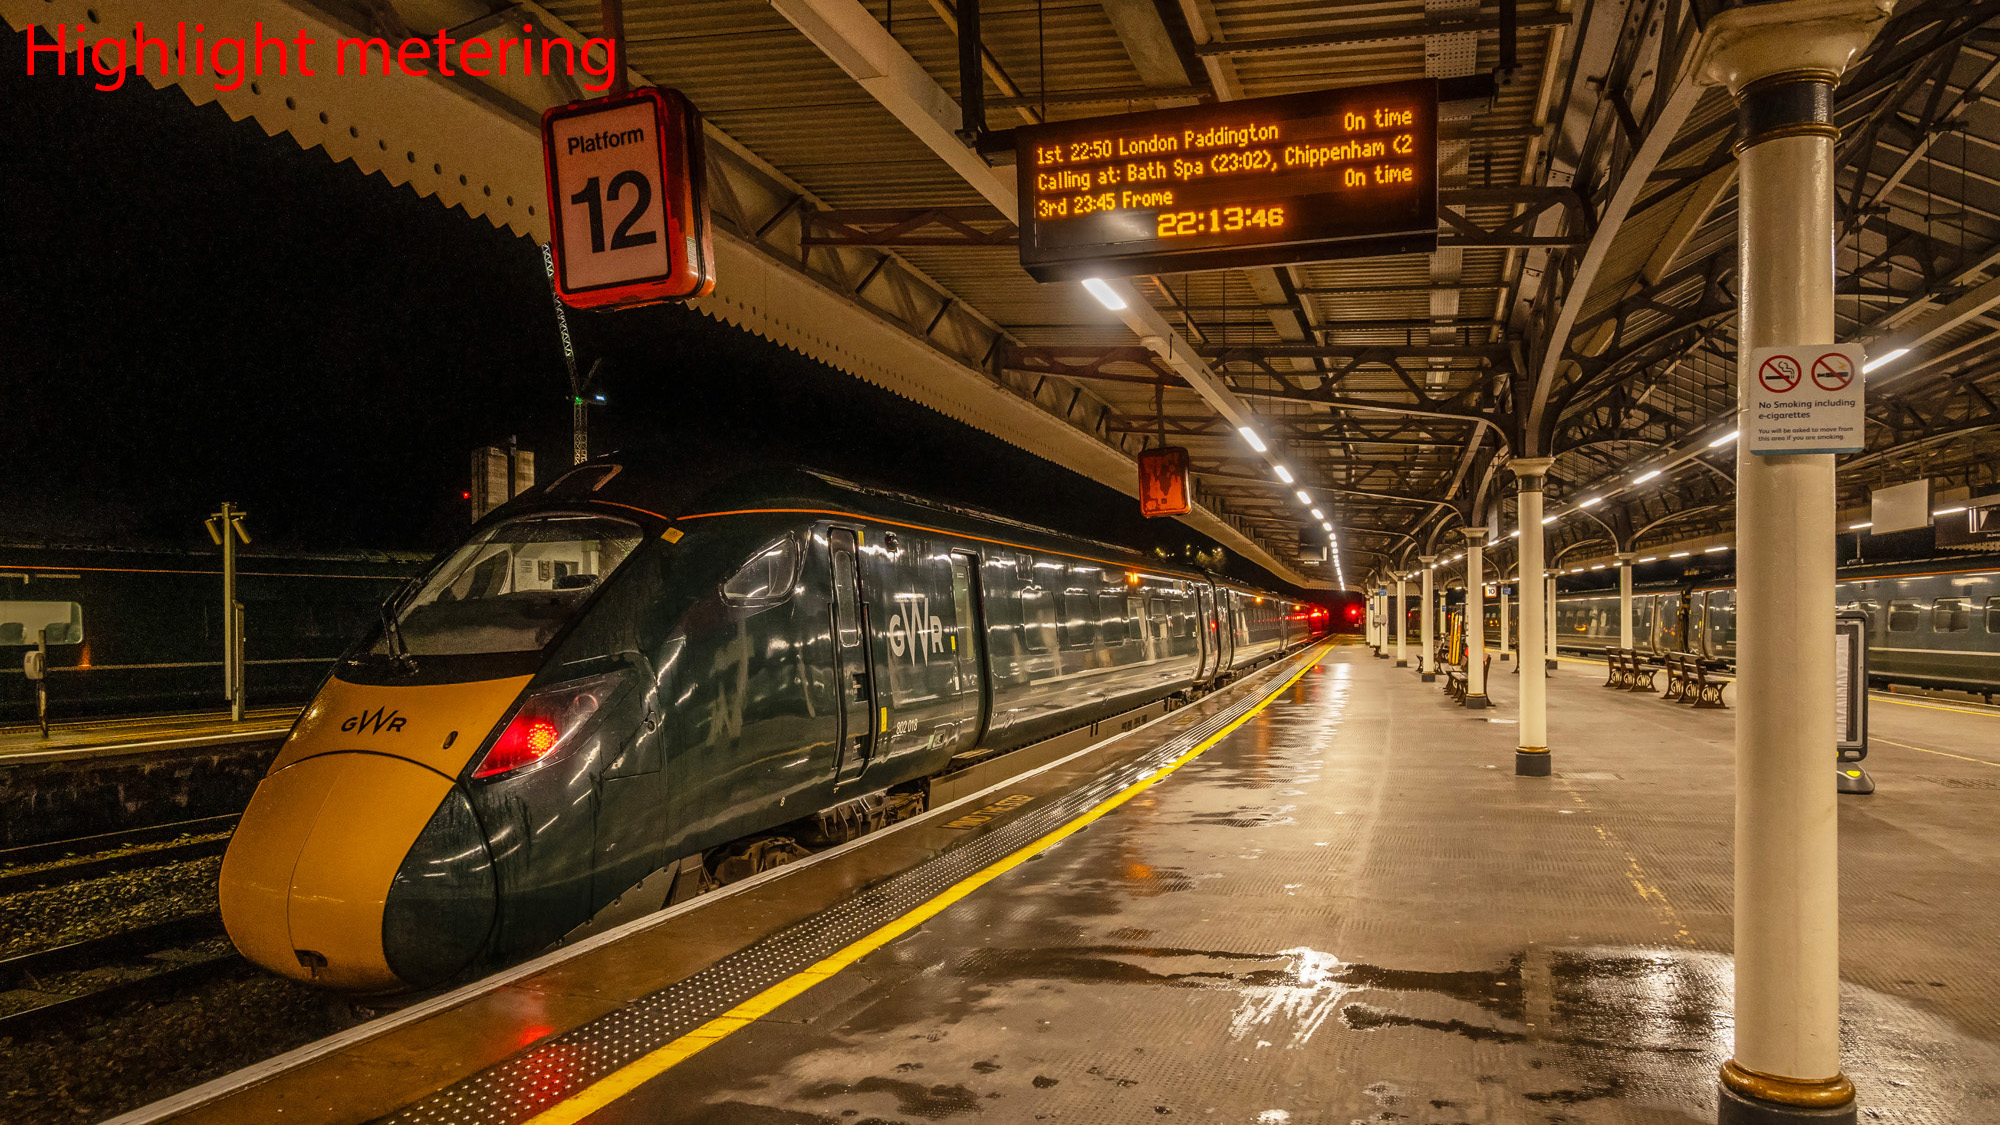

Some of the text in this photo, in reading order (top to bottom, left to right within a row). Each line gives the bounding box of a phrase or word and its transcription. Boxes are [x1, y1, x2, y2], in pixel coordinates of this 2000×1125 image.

[1344, 107, 1413, 132] On time
[567, 127, 644, 155] Platform
[1037, 123, 1279, 165] 1st 22:50 London Paddington
[1037, 133, 1413, 192] Calling at: Bath Spa (23:02), Chippenham (2
[1344, 164, 1413, 188] On time
[571, 170, 657, 254] 12
[1038, 190, 1174, 218] 3rd 23:45 Frome
[1157, 206, 1285, 238] 22:13:46
[1758, 412, 1810, 420] e-cigarettes
[1774, 400, 1812, 409] Smoking
[1814, 399, 1856, 408] including
[889, 583, 944, 667] GWR
[1636, 672, 1651, 686] GWR
[1701, 684, 1719, 701] GWR
[341, 706, 407, 735] GWR
